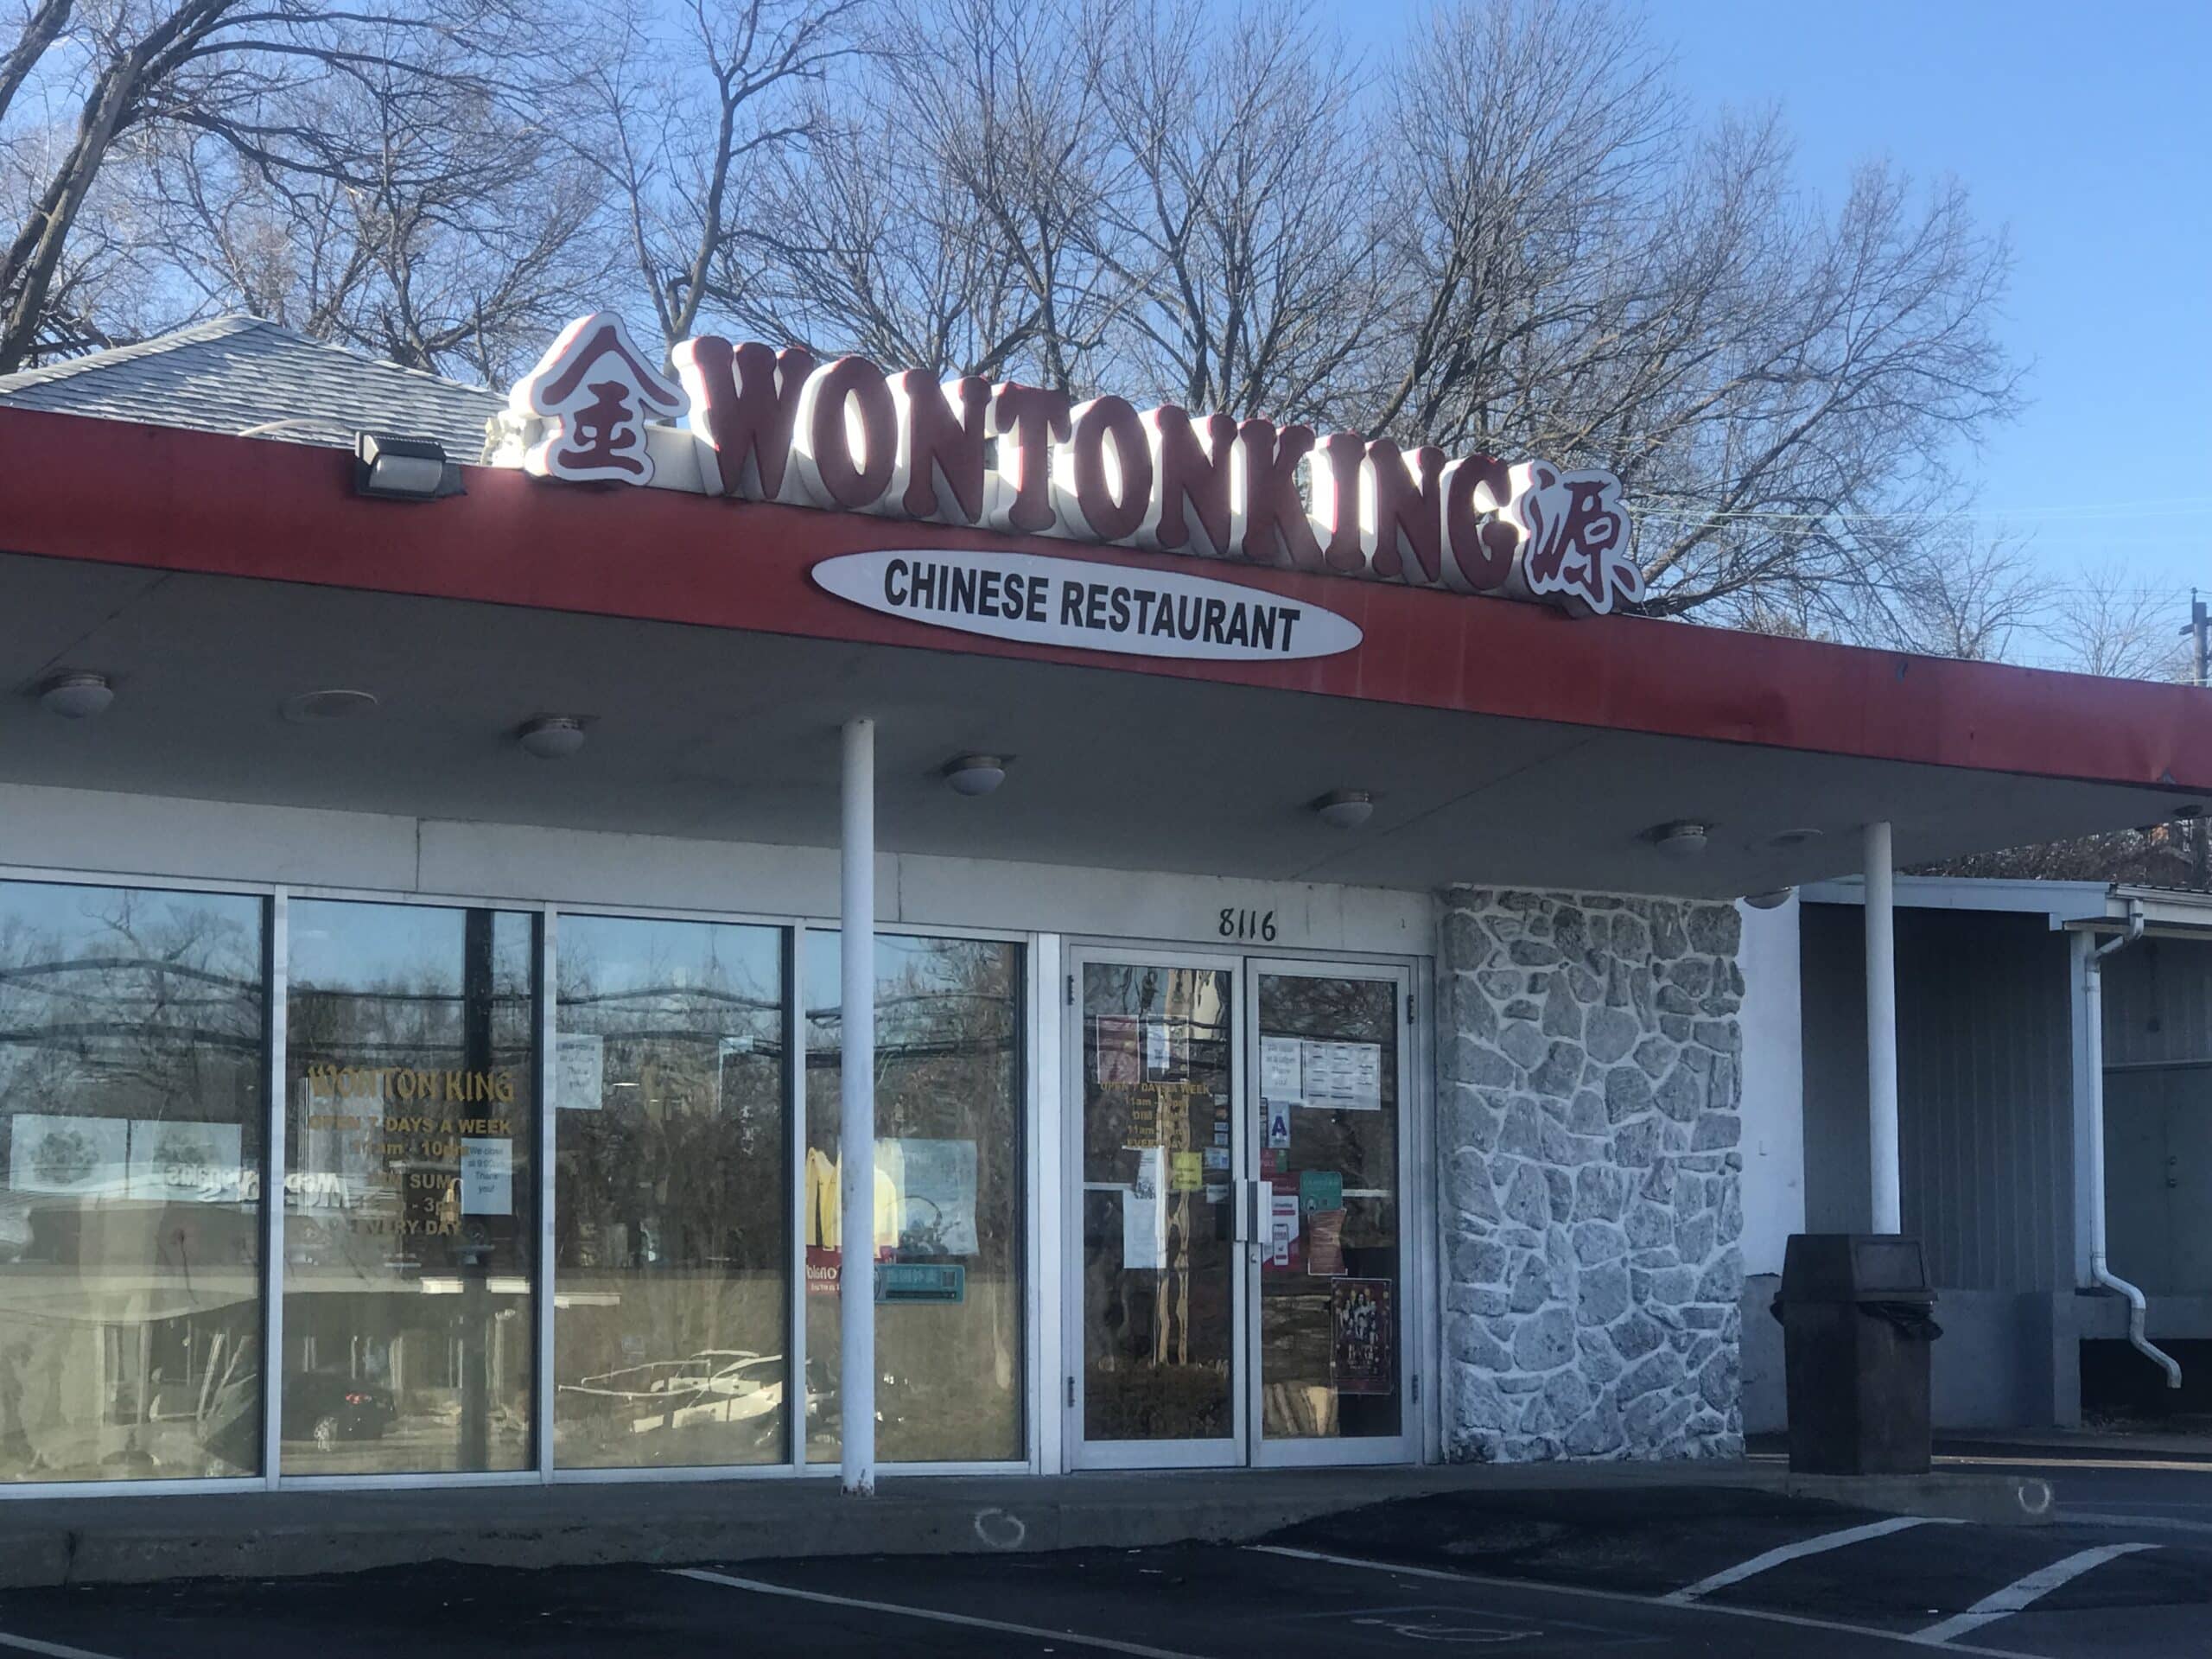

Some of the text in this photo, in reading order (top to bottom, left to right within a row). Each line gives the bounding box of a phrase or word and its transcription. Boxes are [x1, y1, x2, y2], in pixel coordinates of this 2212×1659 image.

[540, 323, 679, 476] 金
[1527, 467, 1641, 598] 源
[884, 559, 1301, 652] CHINESE RESTAURANT
[1219, 906, 1276, 942] 8116
[308, 1064, 515, 1103] WONTON KING
[1180, 1084, 1211, 1094] WEEK
[385, 1117, 432, 1134] DAYS
[440, 1120, 452, 1134] A
[458, 1119, 512, 1135] WEEK
[1272, 1116, 1287, 1136] A
[410, 1173, 452, 1191] SUM
[426, 1219, 461, 1236] DAY
